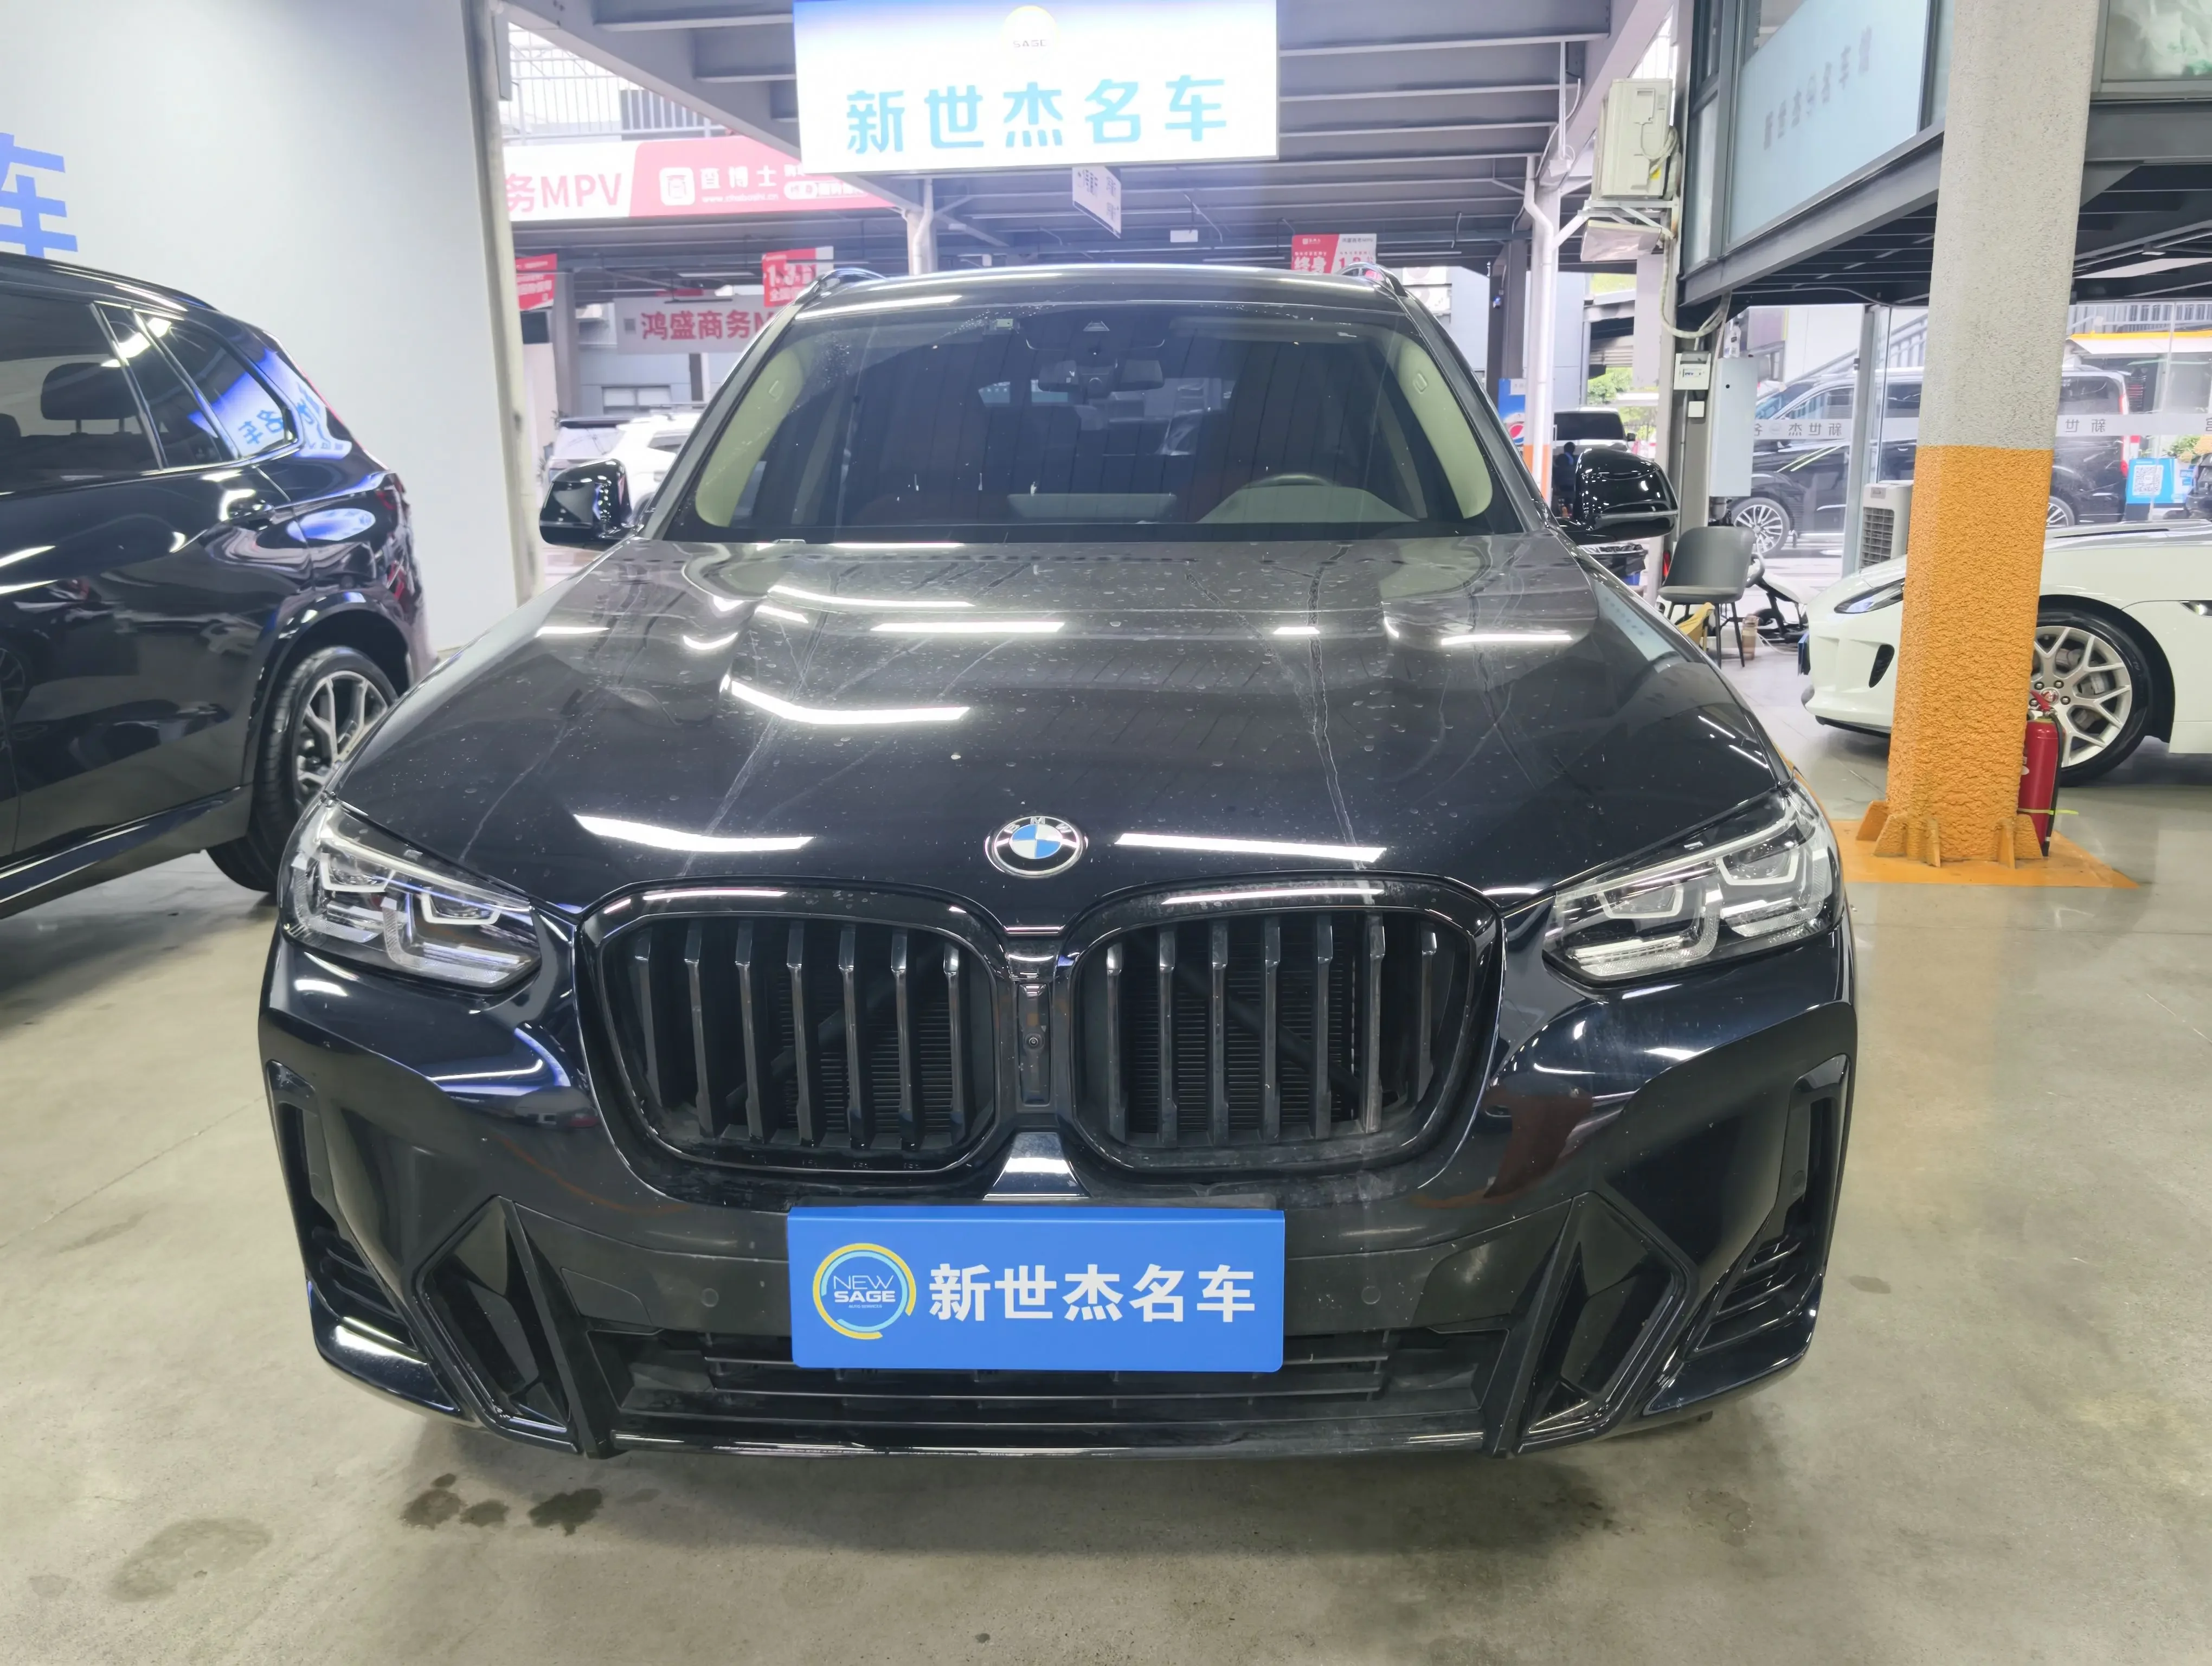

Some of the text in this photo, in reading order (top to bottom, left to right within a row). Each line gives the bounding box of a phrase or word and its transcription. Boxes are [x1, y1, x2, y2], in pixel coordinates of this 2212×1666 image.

[846, 75, 1227, 154] 新世杰名车
[1004, 817, 1072, 834] BMW
[833, 1275, 894, 1290] NEW
[834, 1290, 896, 1303] SAGE
[929, 1263, 1255, 1323] 新世杰名车
